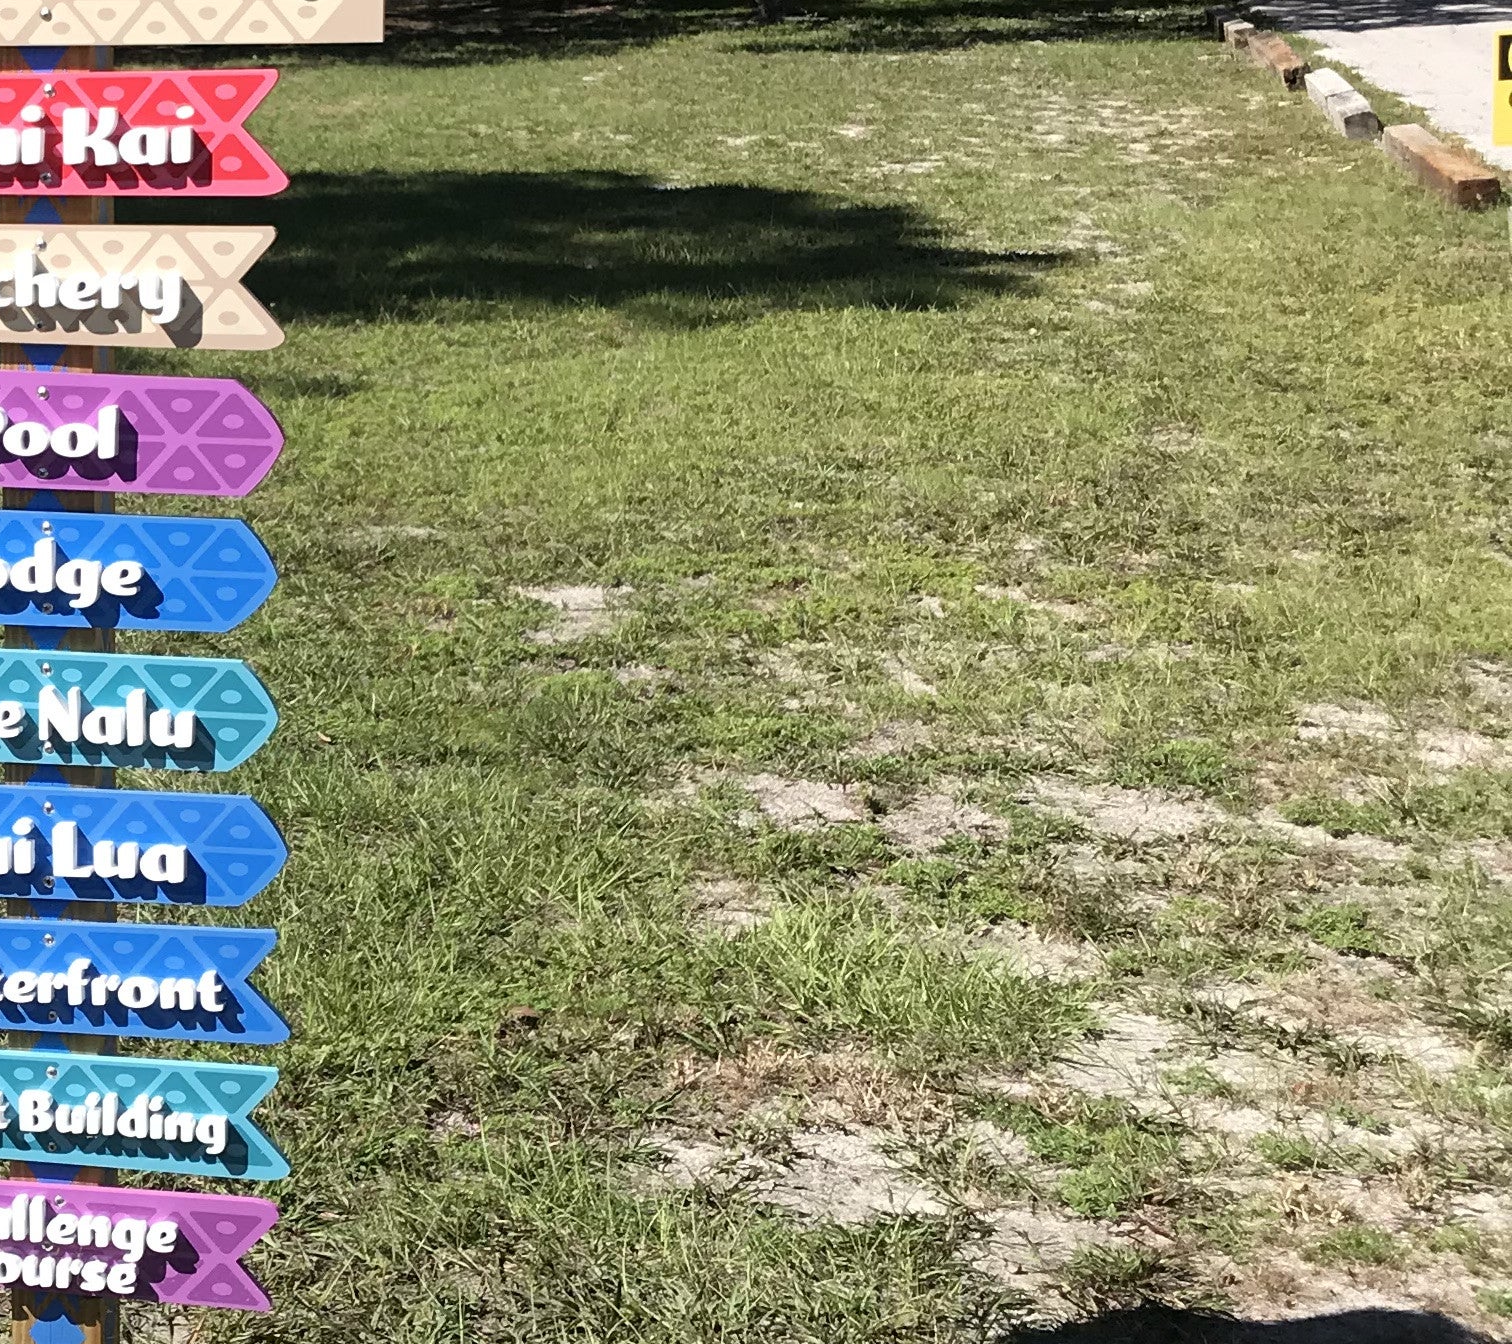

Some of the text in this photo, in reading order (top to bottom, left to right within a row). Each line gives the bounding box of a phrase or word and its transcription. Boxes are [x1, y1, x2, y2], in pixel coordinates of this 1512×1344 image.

[62, 105, 195, 167] Kai
[38, 686, 196, 749] Nalu
[52, 819, 187, 884] Lua
[18, 1089, 229, 1155] Building
